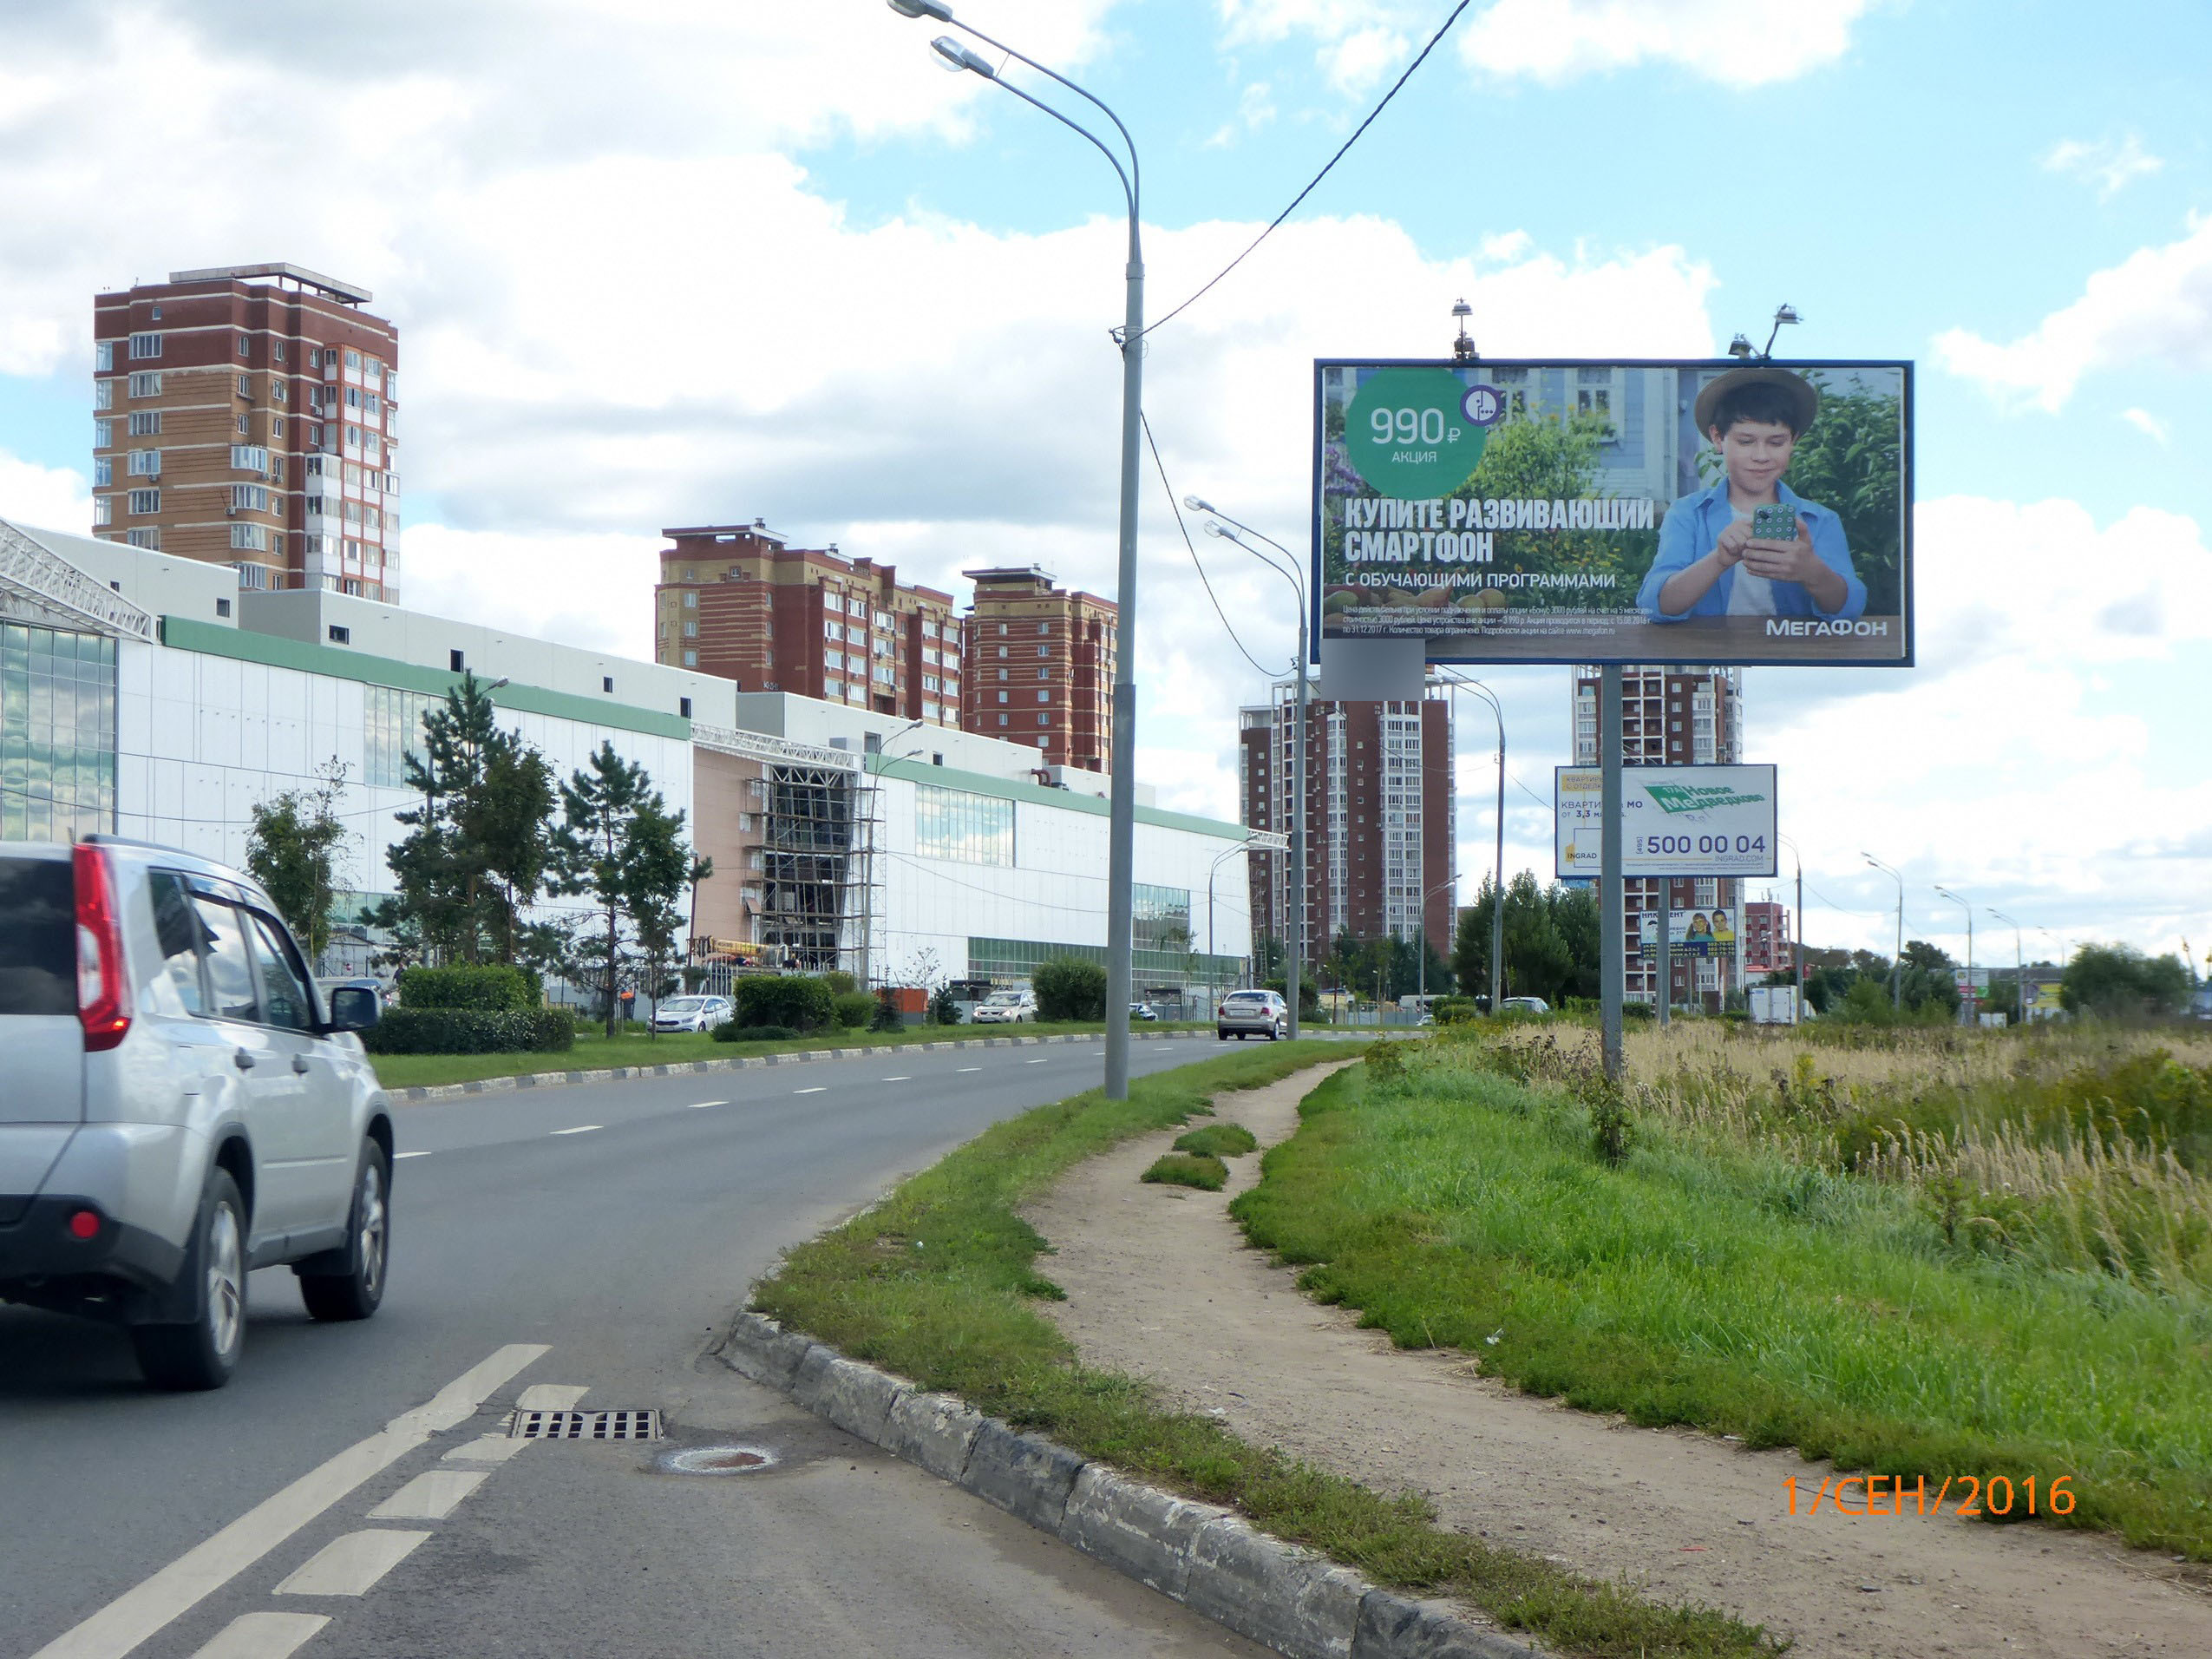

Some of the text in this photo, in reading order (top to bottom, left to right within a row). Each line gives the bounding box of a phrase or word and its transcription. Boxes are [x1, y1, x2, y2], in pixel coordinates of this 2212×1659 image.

[1391, 451, 1437, 464] АКЦИЯ
[1345, 497, 1654, 530] КУПИТЕ РАЗВИВАЮЩИЙ
[1345, 531, 1494, 562] СМАРТФОН
[1345, 573, 1616, 589] С ОБУЧАЮЩИМИ ПРОГРАММАМИ
[1647, 836, 1765, 854] 500 00 04
